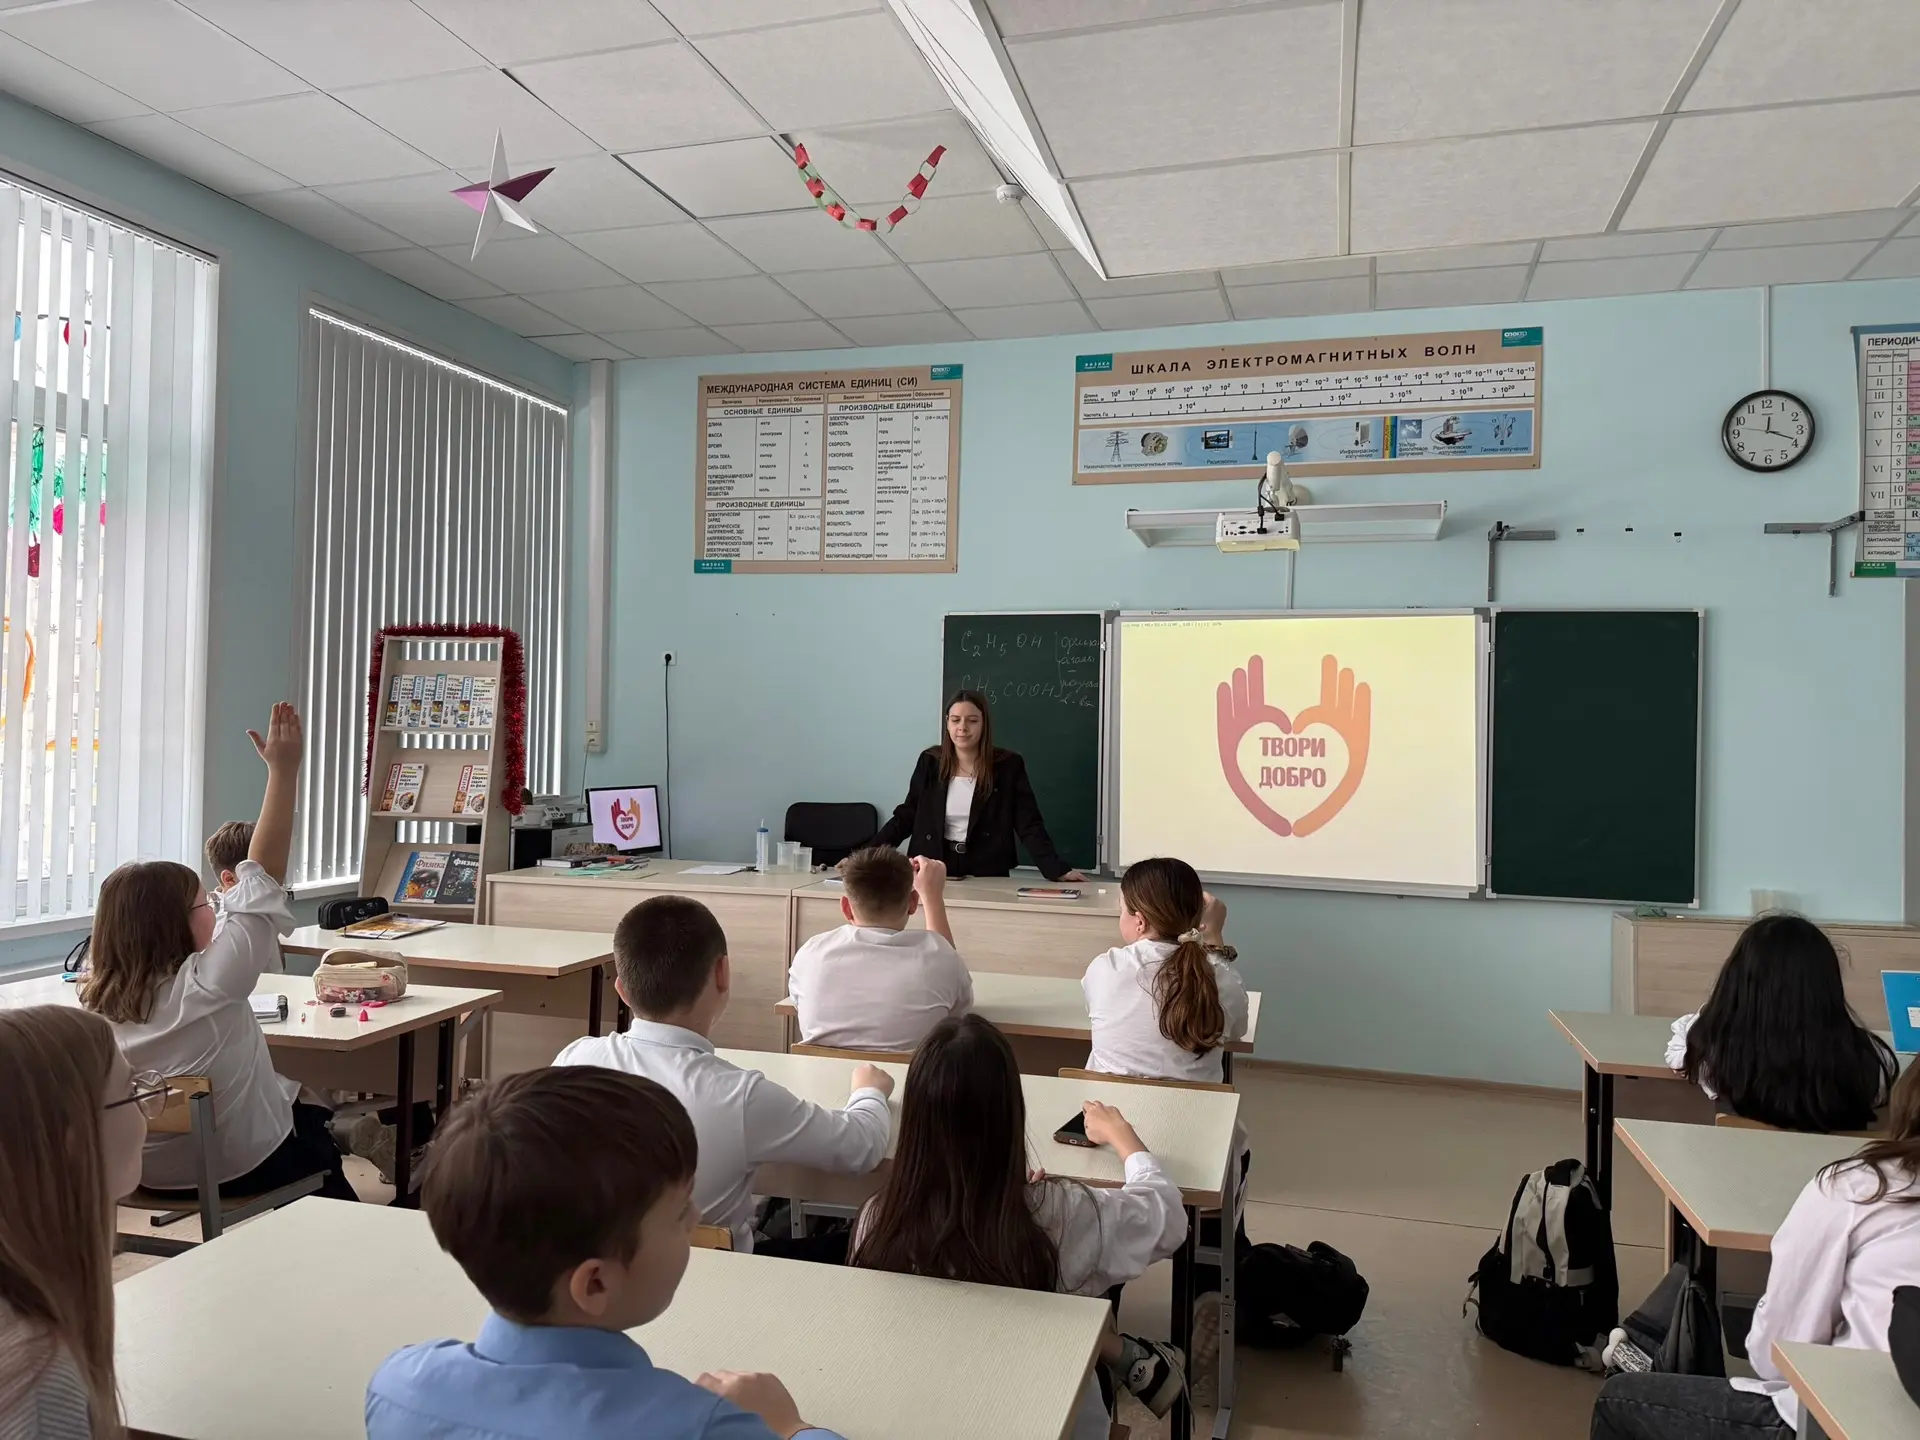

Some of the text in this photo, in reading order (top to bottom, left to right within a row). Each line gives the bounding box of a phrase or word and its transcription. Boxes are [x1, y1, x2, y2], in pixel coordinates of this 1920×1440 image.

[1131, 344, 1475, 374] ШКАЛА ЭЛЕКТРОМАГНИТНЫХ ВОЛН
[706, 377, 918, 394] МЕЖДУНАРОДНАЯ СИСТЕМА ЕДИНИЦ (СИ)
[1762, 399, 1772, 409] 12
[1781, 402, 1784, 411] 1
[1748, 405, 1754, 414] 11
[1736, 416, 1745, 426] 10
[1791, 412, 1798, 421] 2
[1733, 429, 1740, 439] 9
[1796, 425, 1804, 435] 3
[1737, 442, 1745, 452] 8
[1792, 438, 1798, 448] 4
[1749, 452, 1756, 461] 7
[1765, 454, 1772, 464] 6
[1781, 450, 1788, 460] 5
[1259, 737, 1326, 757] ТВОРИ
[1259, 766, 1326, 789] ДОБРО
[416, 860, 446, 869] Физика
